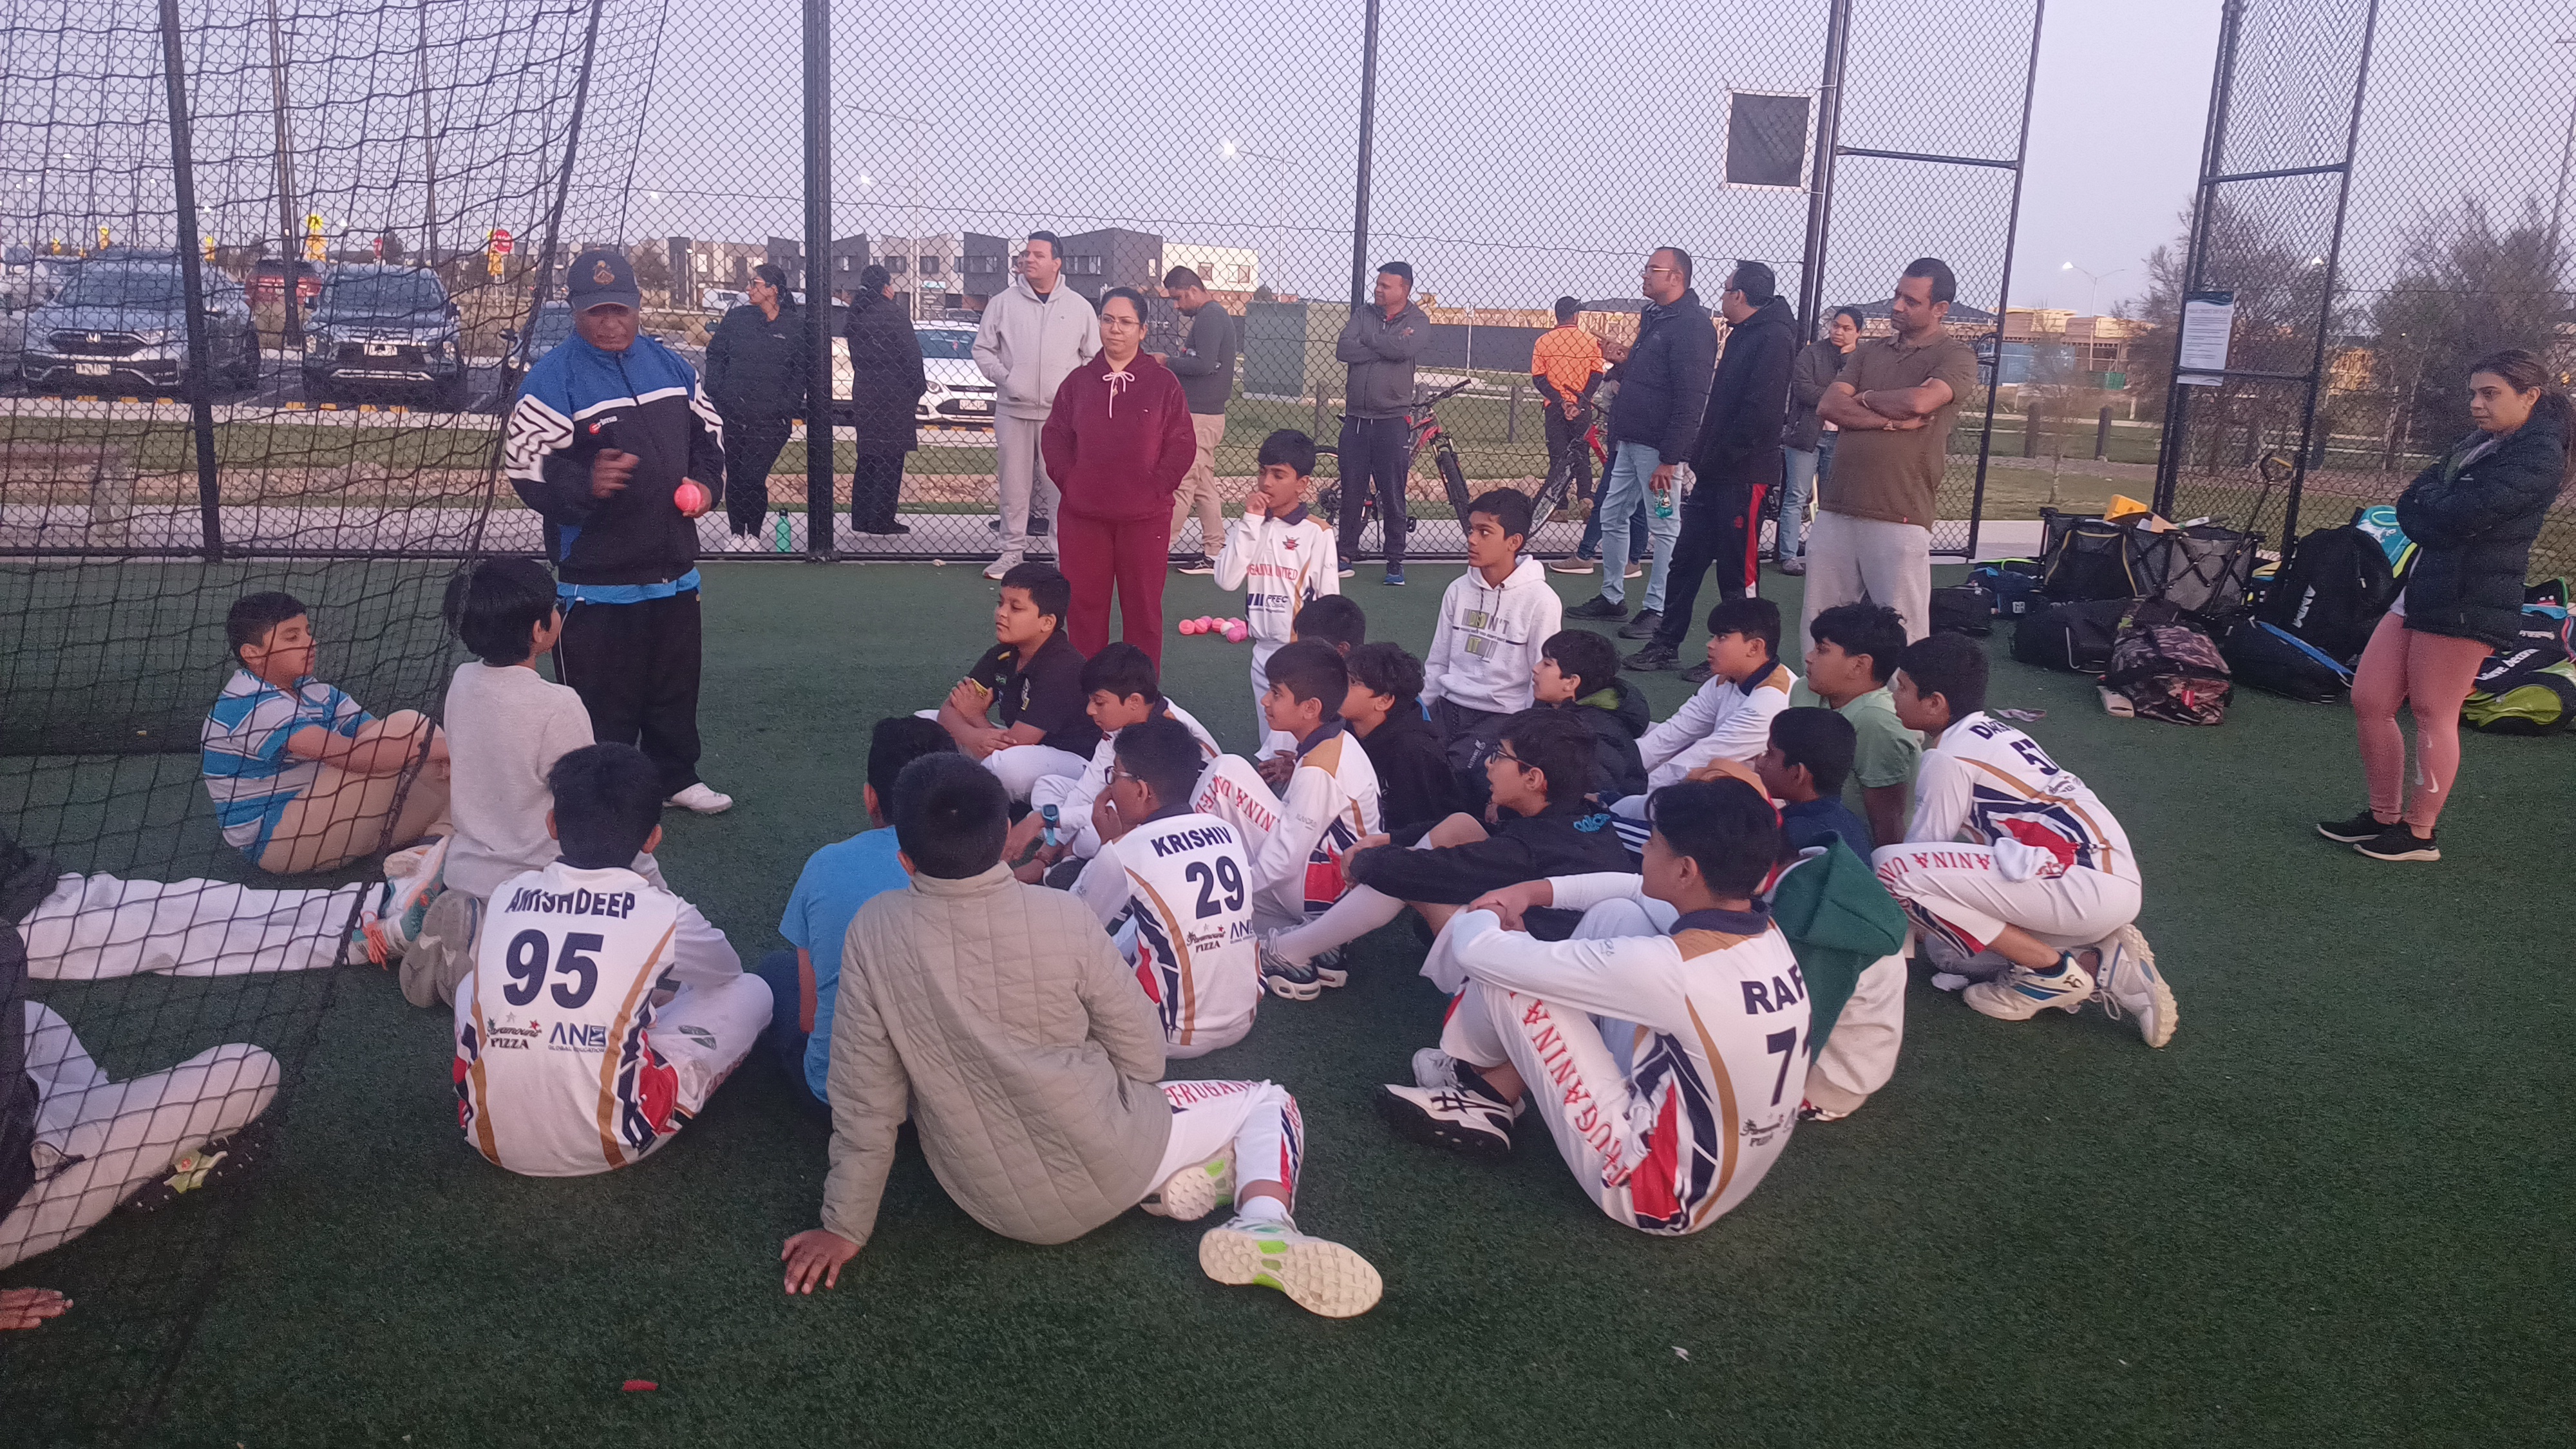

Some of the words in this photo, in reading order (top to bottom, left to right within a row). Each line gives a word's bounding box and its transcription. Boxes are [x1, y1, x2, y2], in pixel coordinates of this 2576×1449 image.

[1150, 826, 1233, 858] KRISHIV
[1185, 856, 1244, 920] 29
[503, 929, 605, 1009] 95
[490, 1037, 530, 1050] PIZZA
